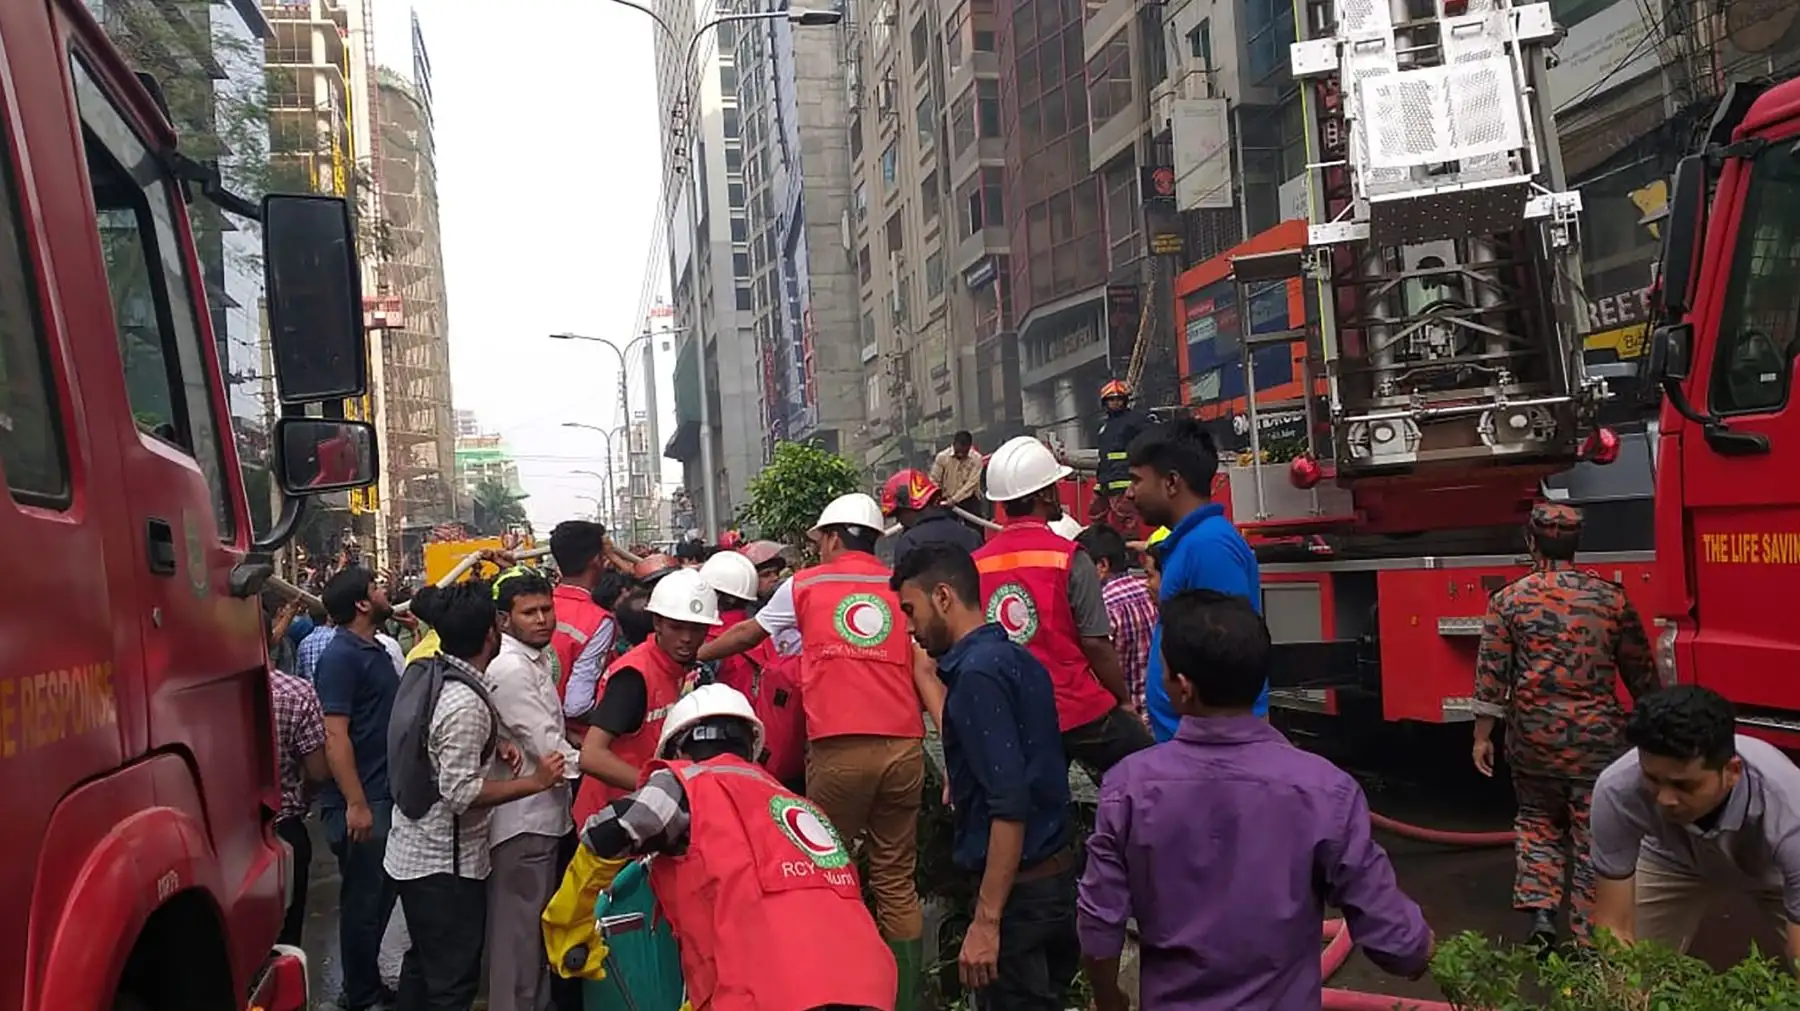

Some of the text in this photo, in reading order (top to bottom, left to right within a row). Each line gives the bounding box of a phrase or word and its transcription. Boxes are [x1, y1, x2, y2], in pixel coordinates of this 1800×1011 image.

[1703, 533, 1728, 563] THE
[1731, 533, 1759, 563] LIFE
[0, 660, 117, 759] E RESPONSE
[781, 861, 816, 879] RCY
